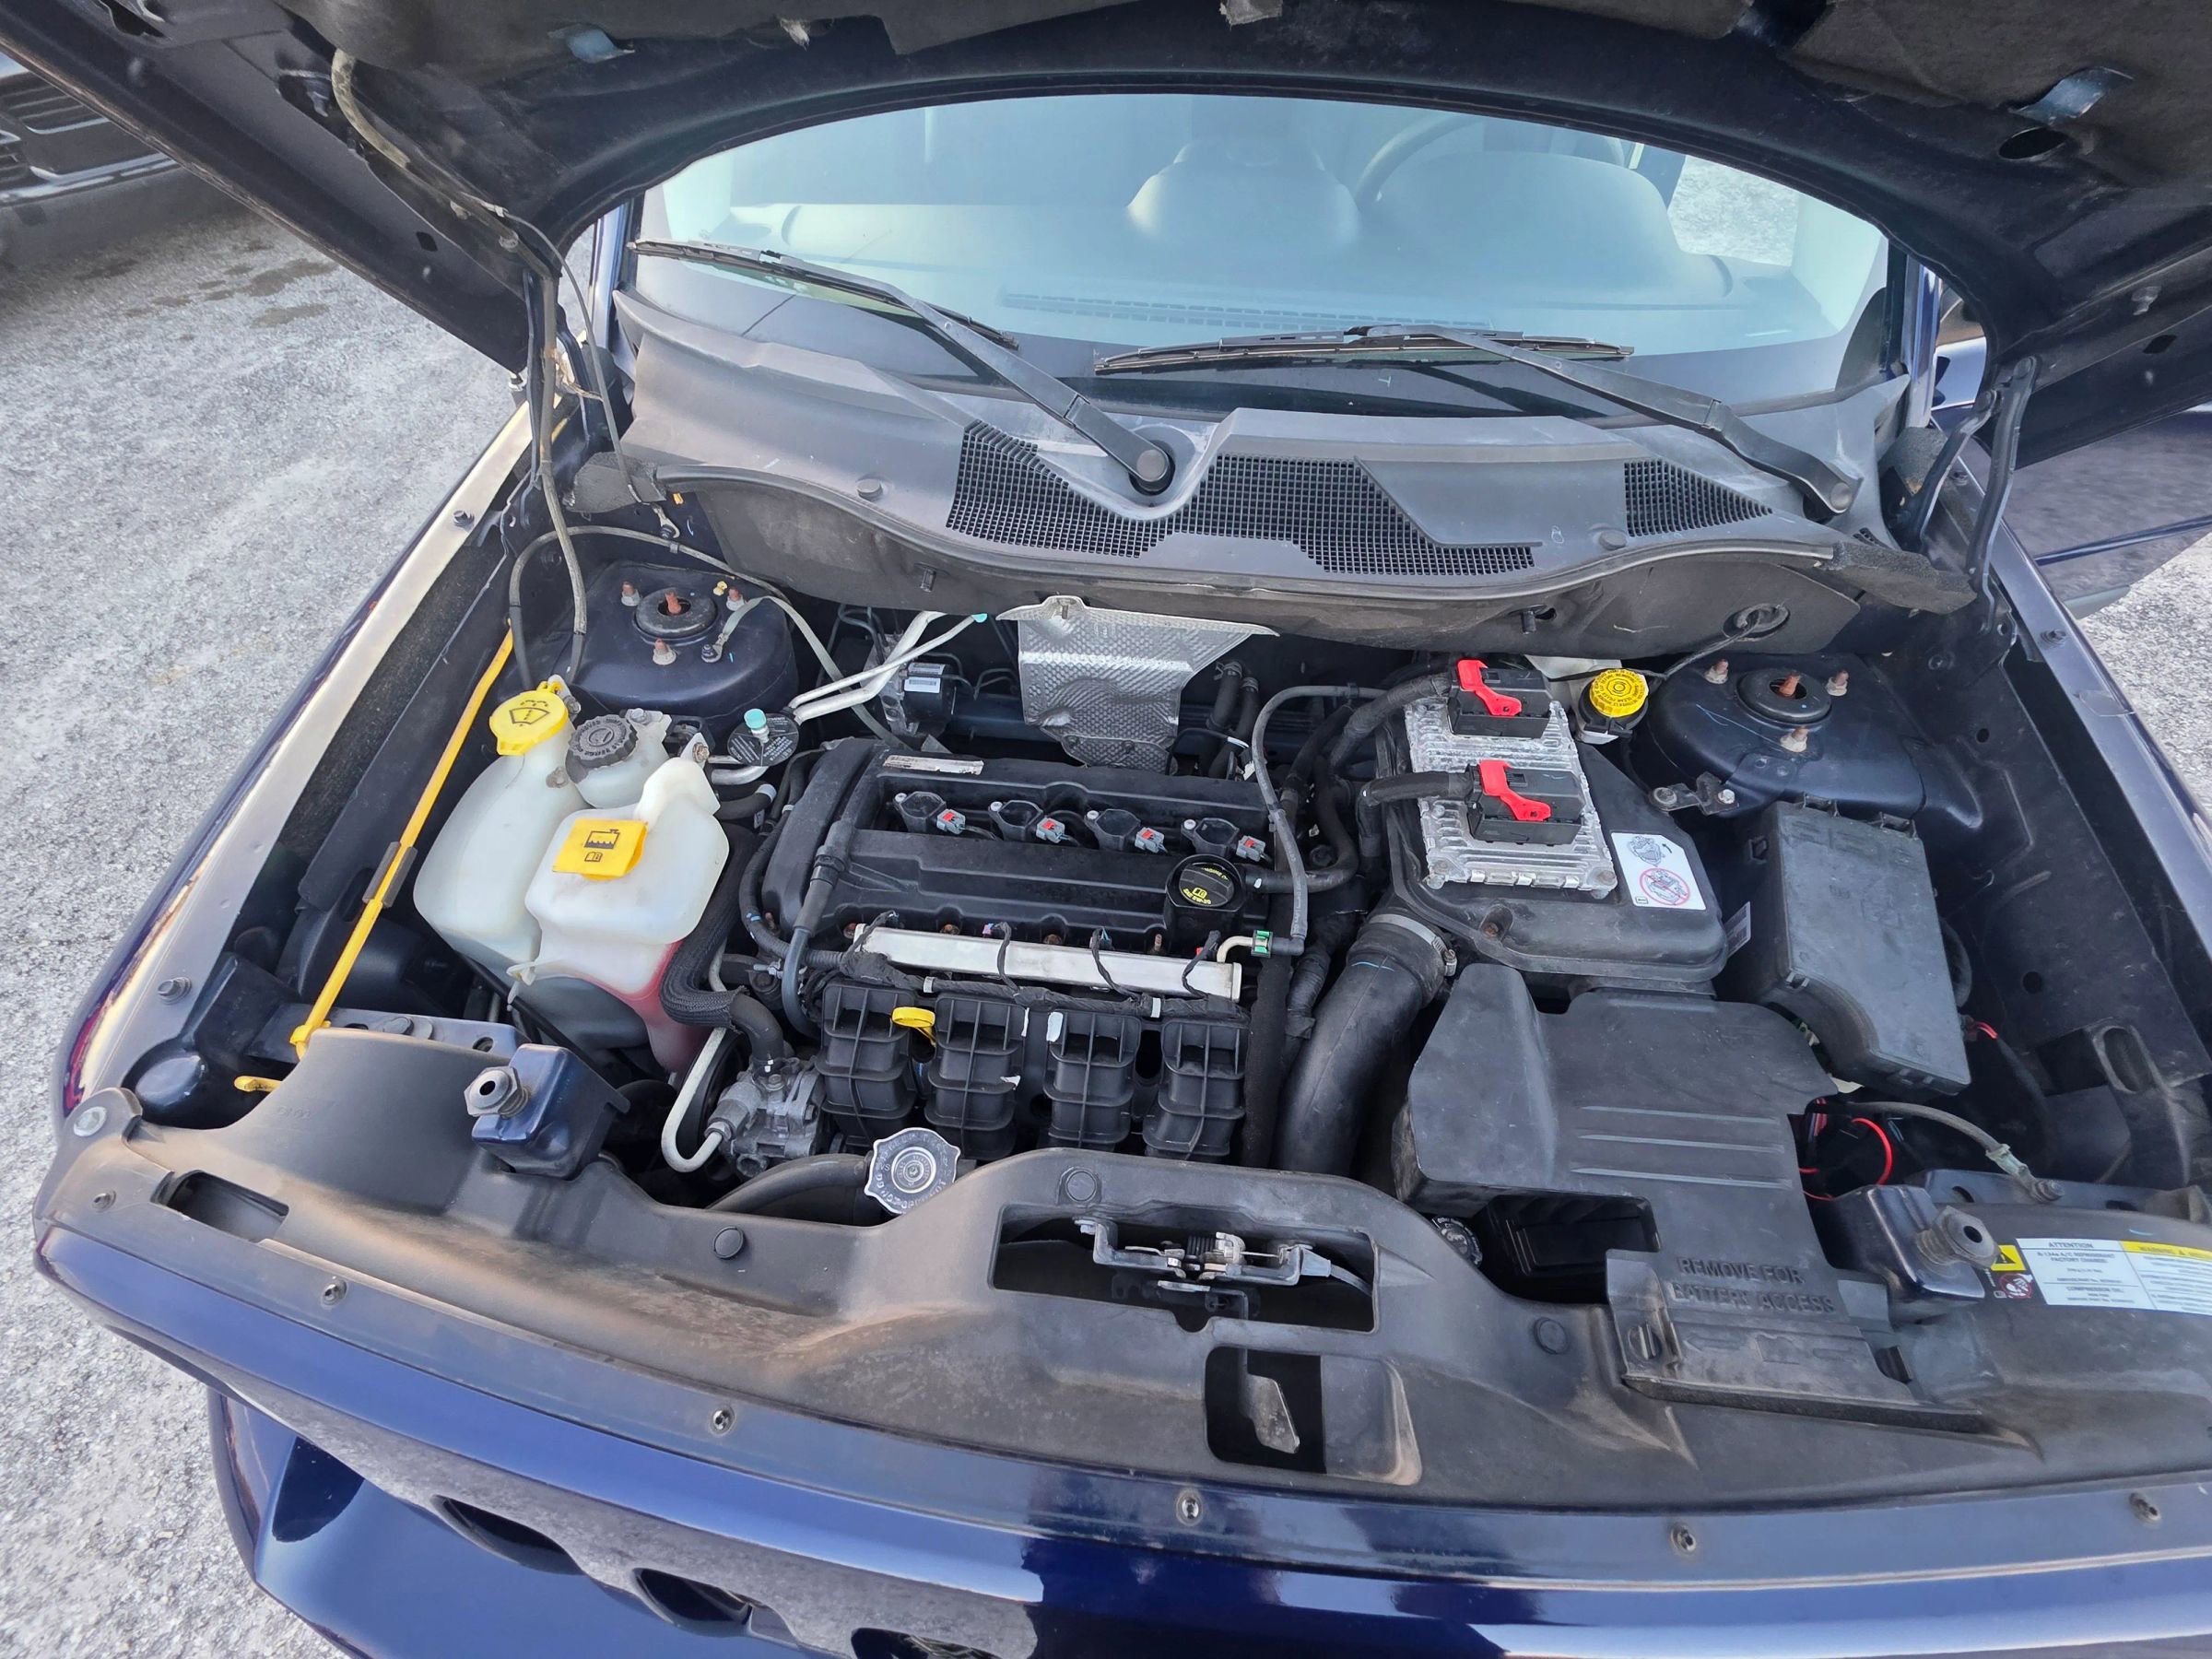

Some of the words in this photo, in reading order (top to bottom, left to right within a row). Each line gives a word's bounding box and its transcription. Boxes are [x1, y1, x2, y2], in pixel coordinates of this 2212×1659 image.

[1677, 1256, 1756, 1279] REMOVE
[1760, 1265, 1806, 1284] FOR
[1671, 1282, 1752, 1309] BATTERY
[1758, 1293, 1836, 1313] ACCESS
